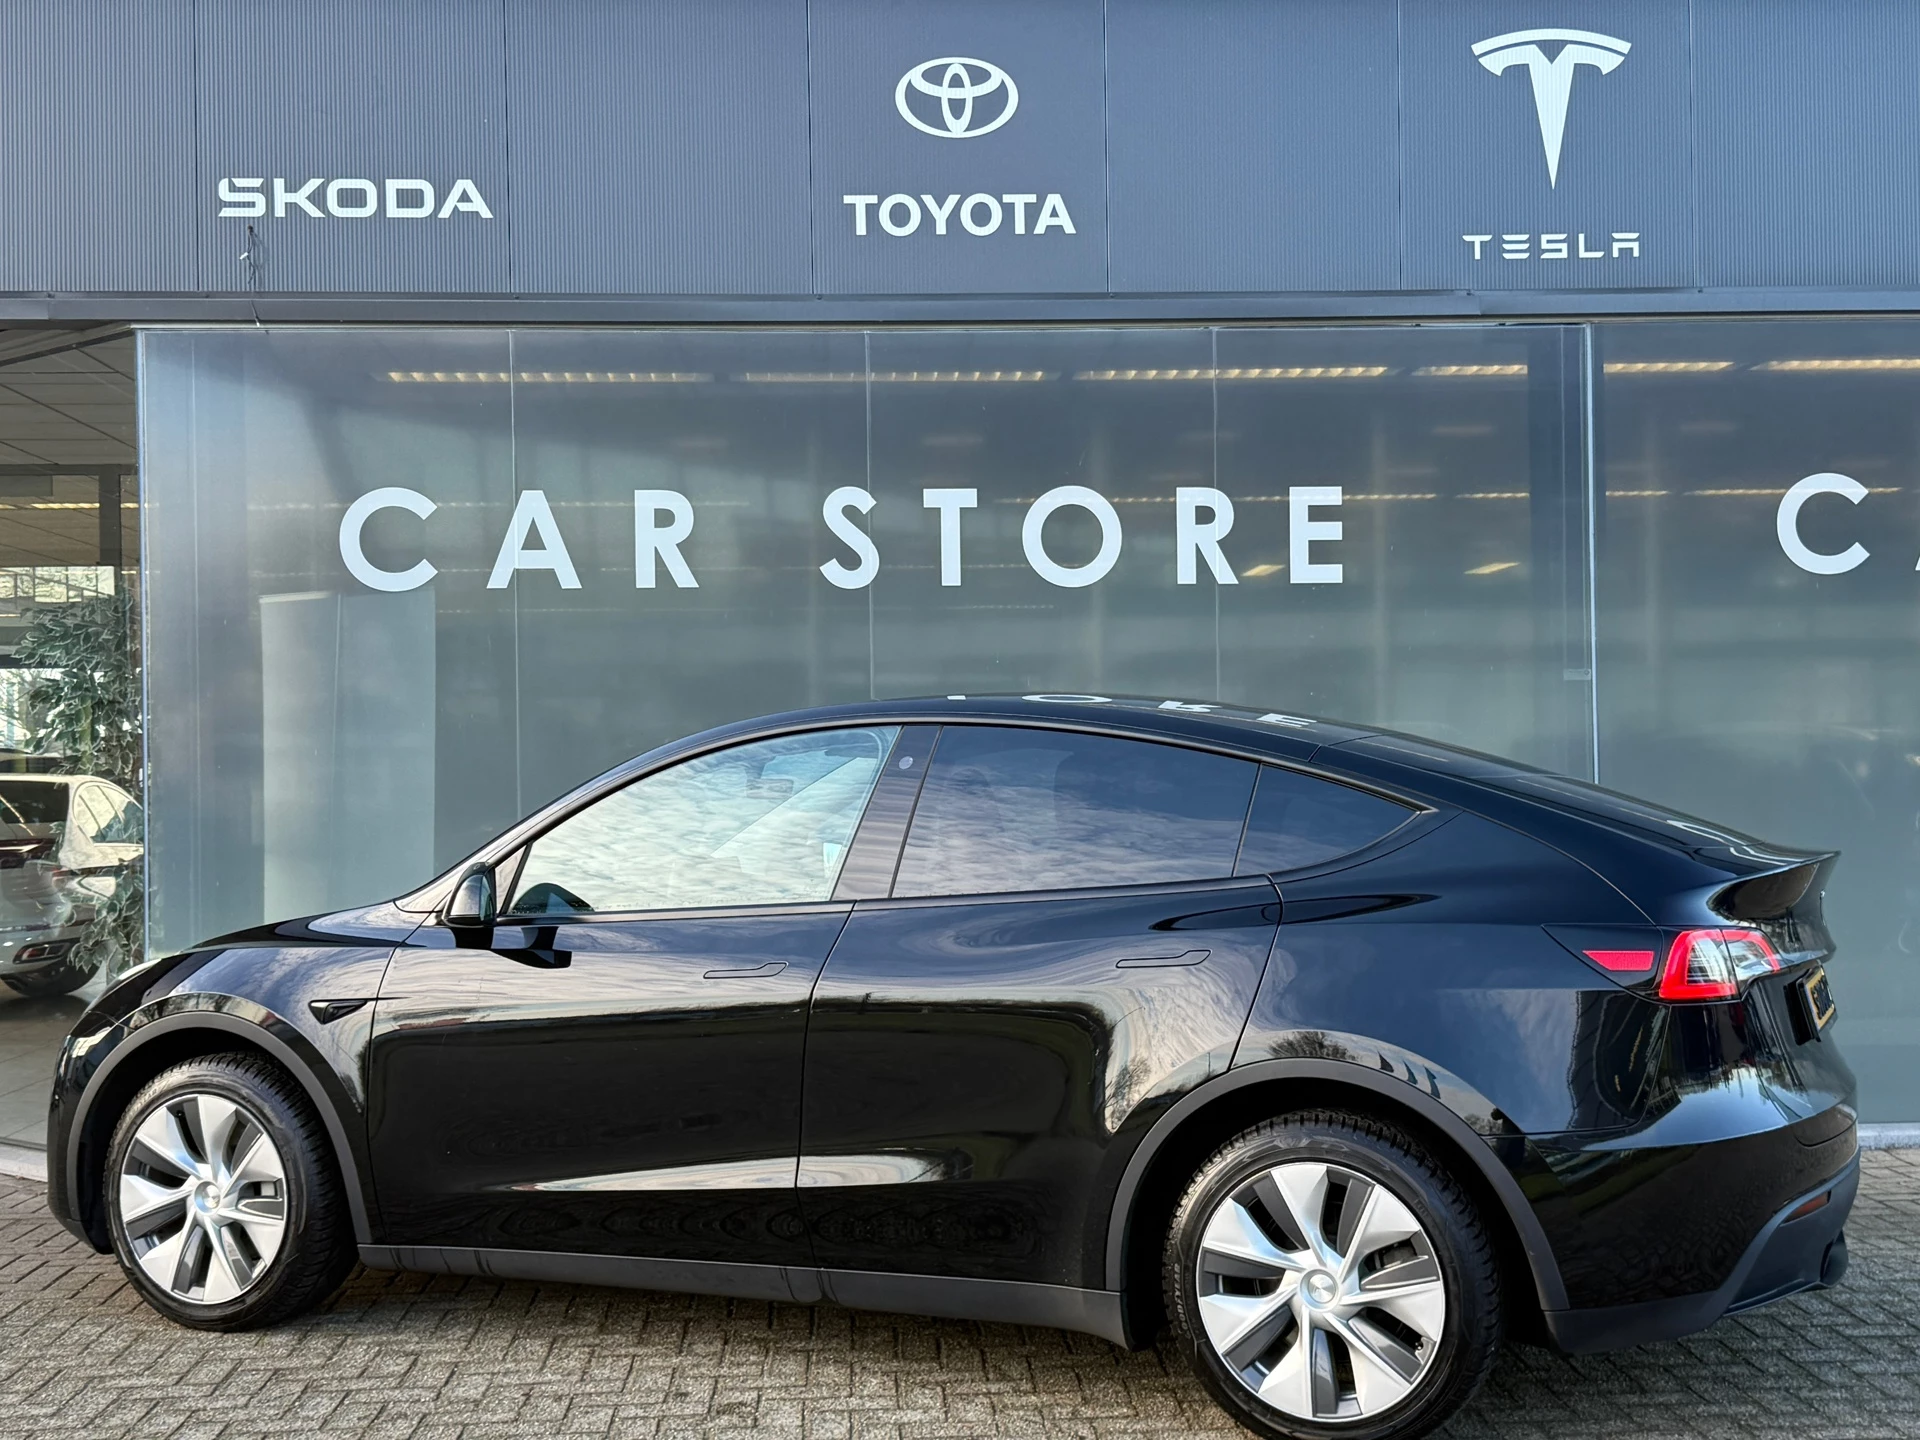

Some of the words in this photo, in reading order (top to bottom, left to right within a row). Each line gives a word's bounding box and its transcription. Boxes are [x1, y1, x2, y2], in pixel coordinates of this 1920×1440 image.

[843, 192, 1077, 237] TOYOTA
[1462, 232, 1640, 260] TESLA
[338, 486, 700, 592] CAR
[819, 485, 1344, 590] STORE
[1776, 472, 1920, 575] C
